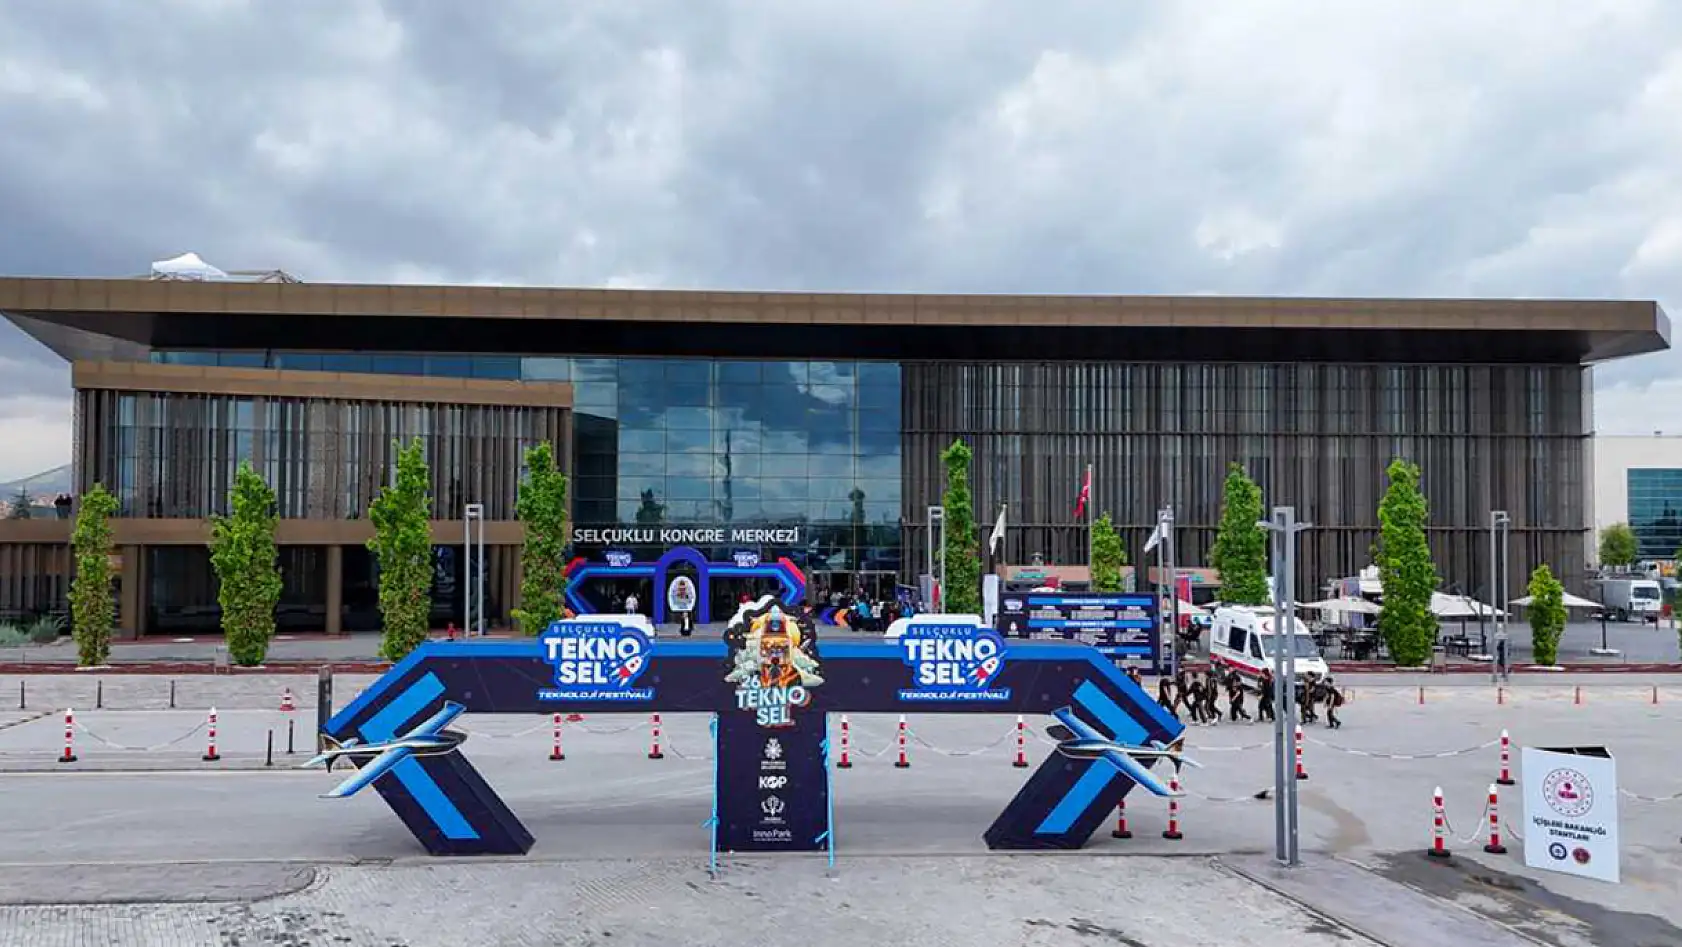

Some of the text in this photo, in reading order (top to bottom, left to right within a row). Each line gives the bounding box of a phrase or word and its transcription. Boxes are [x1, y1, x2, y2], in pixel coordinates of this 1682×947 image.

[574, 526, 798, 546] SELÇUKLU KONGRE MERKEZİ
[544, 637, 641, 660] TEKNO
[904, 638, 997, 661] TEKNO
[558, 660, 608, 684] SEL
[919, 661, 967, 684] SEL
[734, 685, 806, 709] TEKNO
[756, 706, 792, 726] SEL
